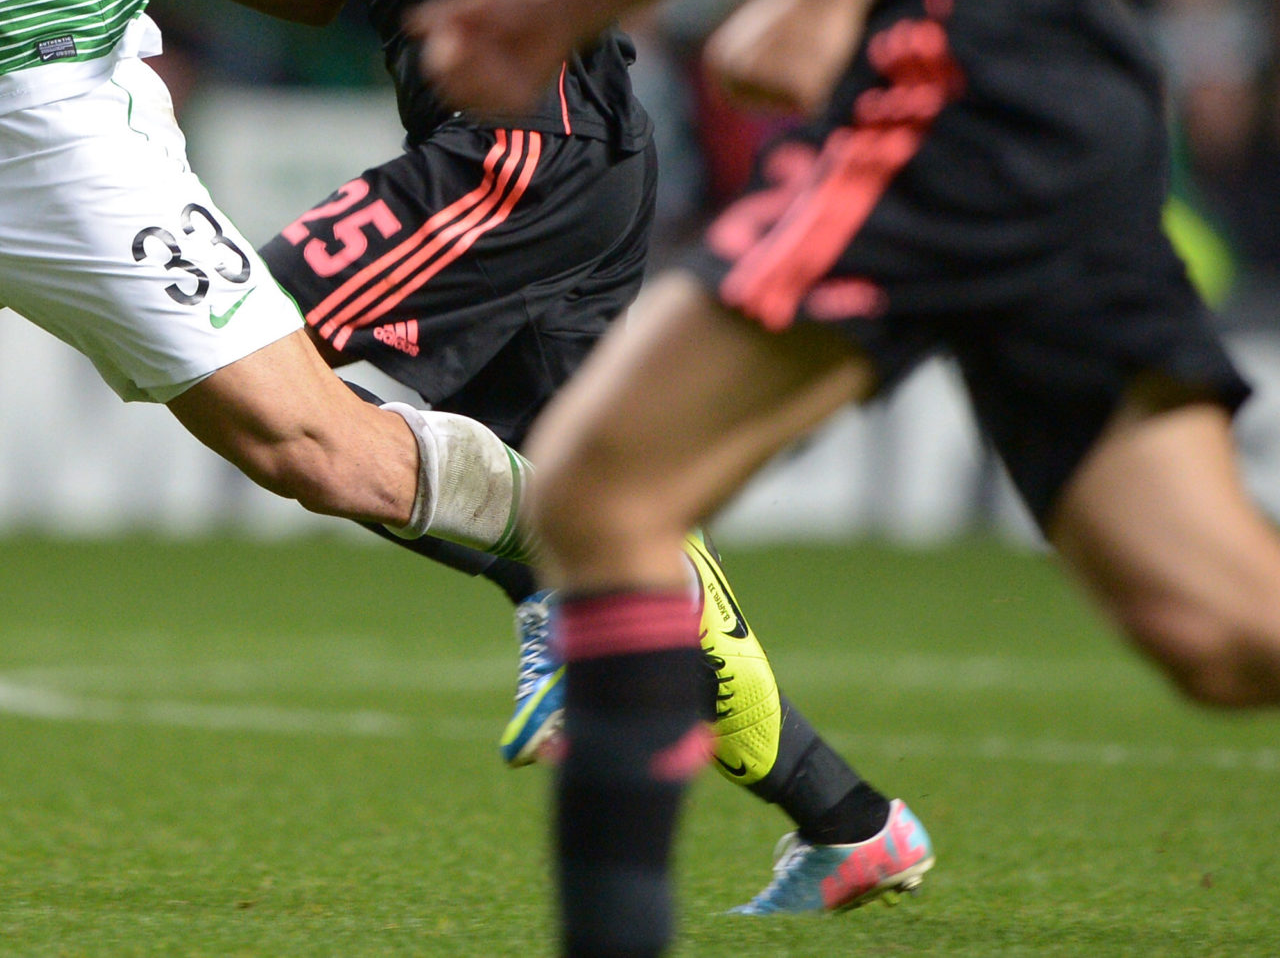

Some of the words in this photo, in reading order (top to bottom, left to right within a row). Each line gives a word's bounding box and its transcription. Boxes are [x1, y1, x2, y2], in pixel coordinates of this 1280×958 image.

[132, 203, 251, 305] 33
[281, 177, 402, 277] 25
[373, 326, 420, 357] adidas
